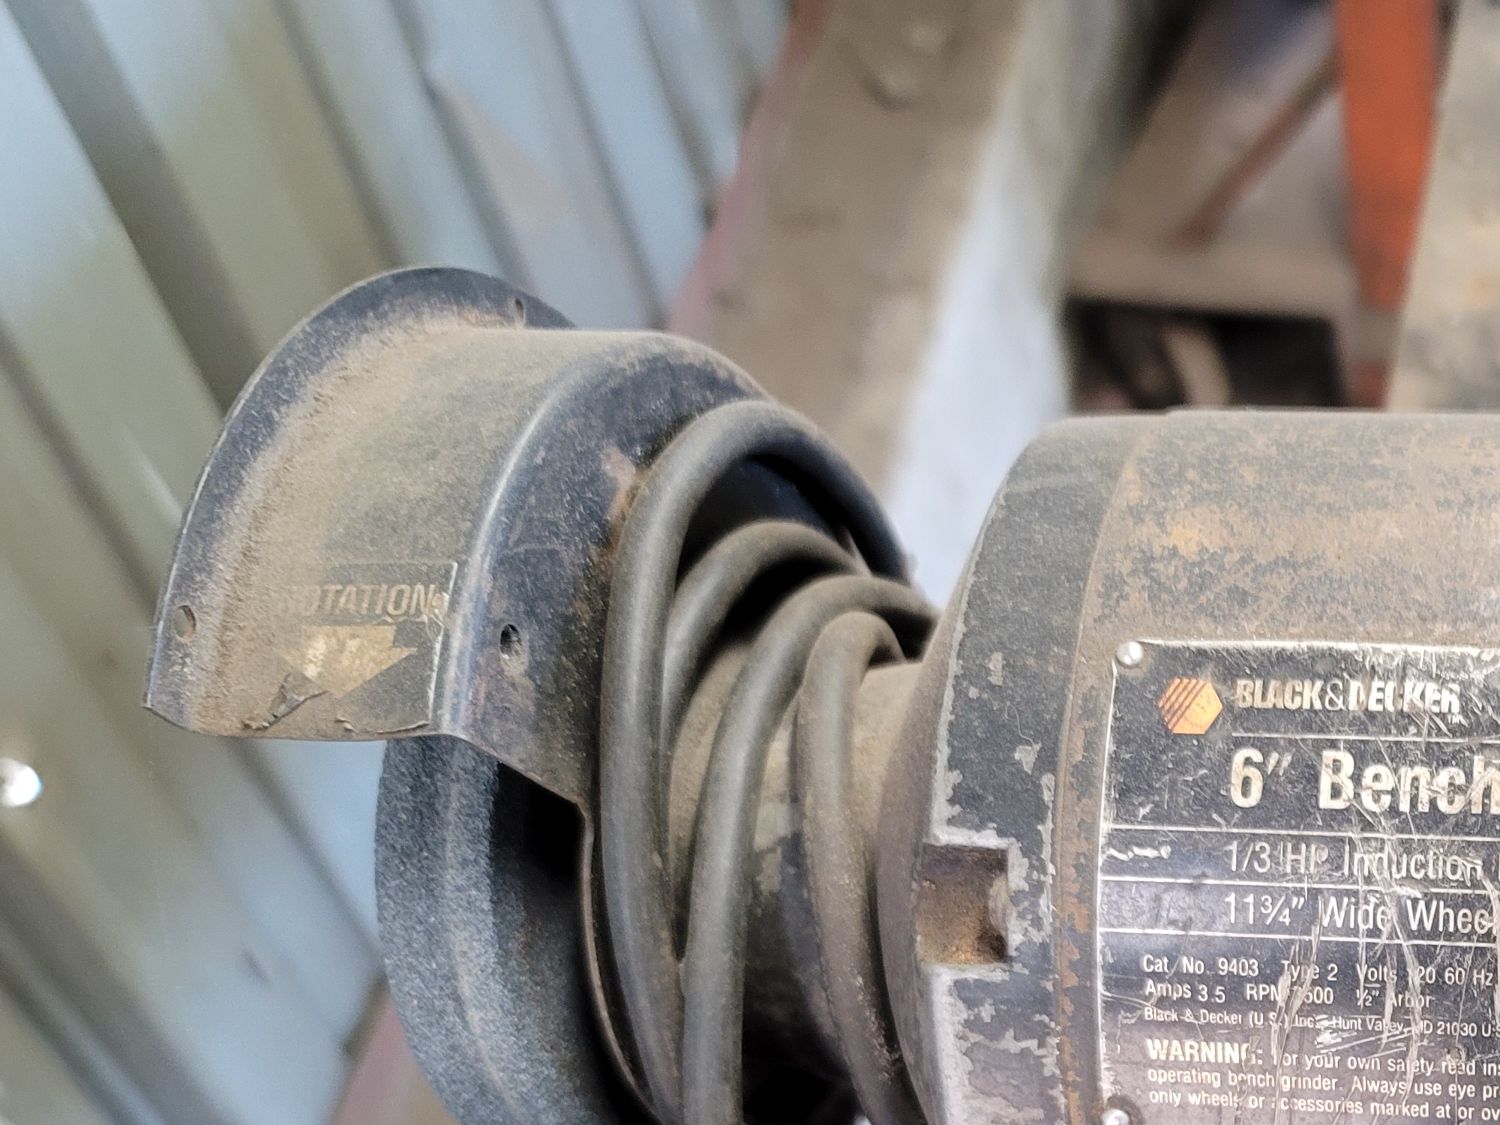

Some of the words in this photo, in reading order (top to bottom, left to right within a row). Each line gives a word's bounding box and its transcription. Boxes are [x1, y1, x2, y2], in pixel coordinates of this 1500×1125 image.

[287, 583, 437, 617] OTATION
[1228, 840, 1271, 873] 1/3
[1286, 842, 1329, 874] HP
[1344, 844, 1482, 882] Induction
[1321, 896, 1391, 931] Wide
[1217, 957, 1259, 976] 9403
[1327, 962, 1338, 981] 2
[1444, 967, 1466, 986] 60
[1473, 968, 1494, 986] Hz
[1145, 978, 1192, 1001] Amps
[1291, 986, 1334, 1005] 600
[1144, 1007, 1179, 1023] Black
[1200, 1009, 1242, 1026] Decker
[1436, 1021, 1478, 1037] 21030
[1304, 1054, 1342, 1071] your
[1348, 1056, 1381, 1071] own
[1441, 1058, 1476, 1076] read
[1149, 1069, 1221, 1087] operating
[1228, 1070, 1274, 1087] bench
[1350, 1074, 1407, 1096] Always
[1414, 1082, 1443, 1097] use
[1448, 1083, 1476, 1101] eye
[1150, 1089, 1182, 1106] only
[1189, 1090, 1240, 1108] wheels
[1249, 1096, 1266, 1110] or
[1370, 1101, 1429, 1118] marked
[1435, 1102, 1452, 1119] at
[1457, 1106, 1475, 1121] or
